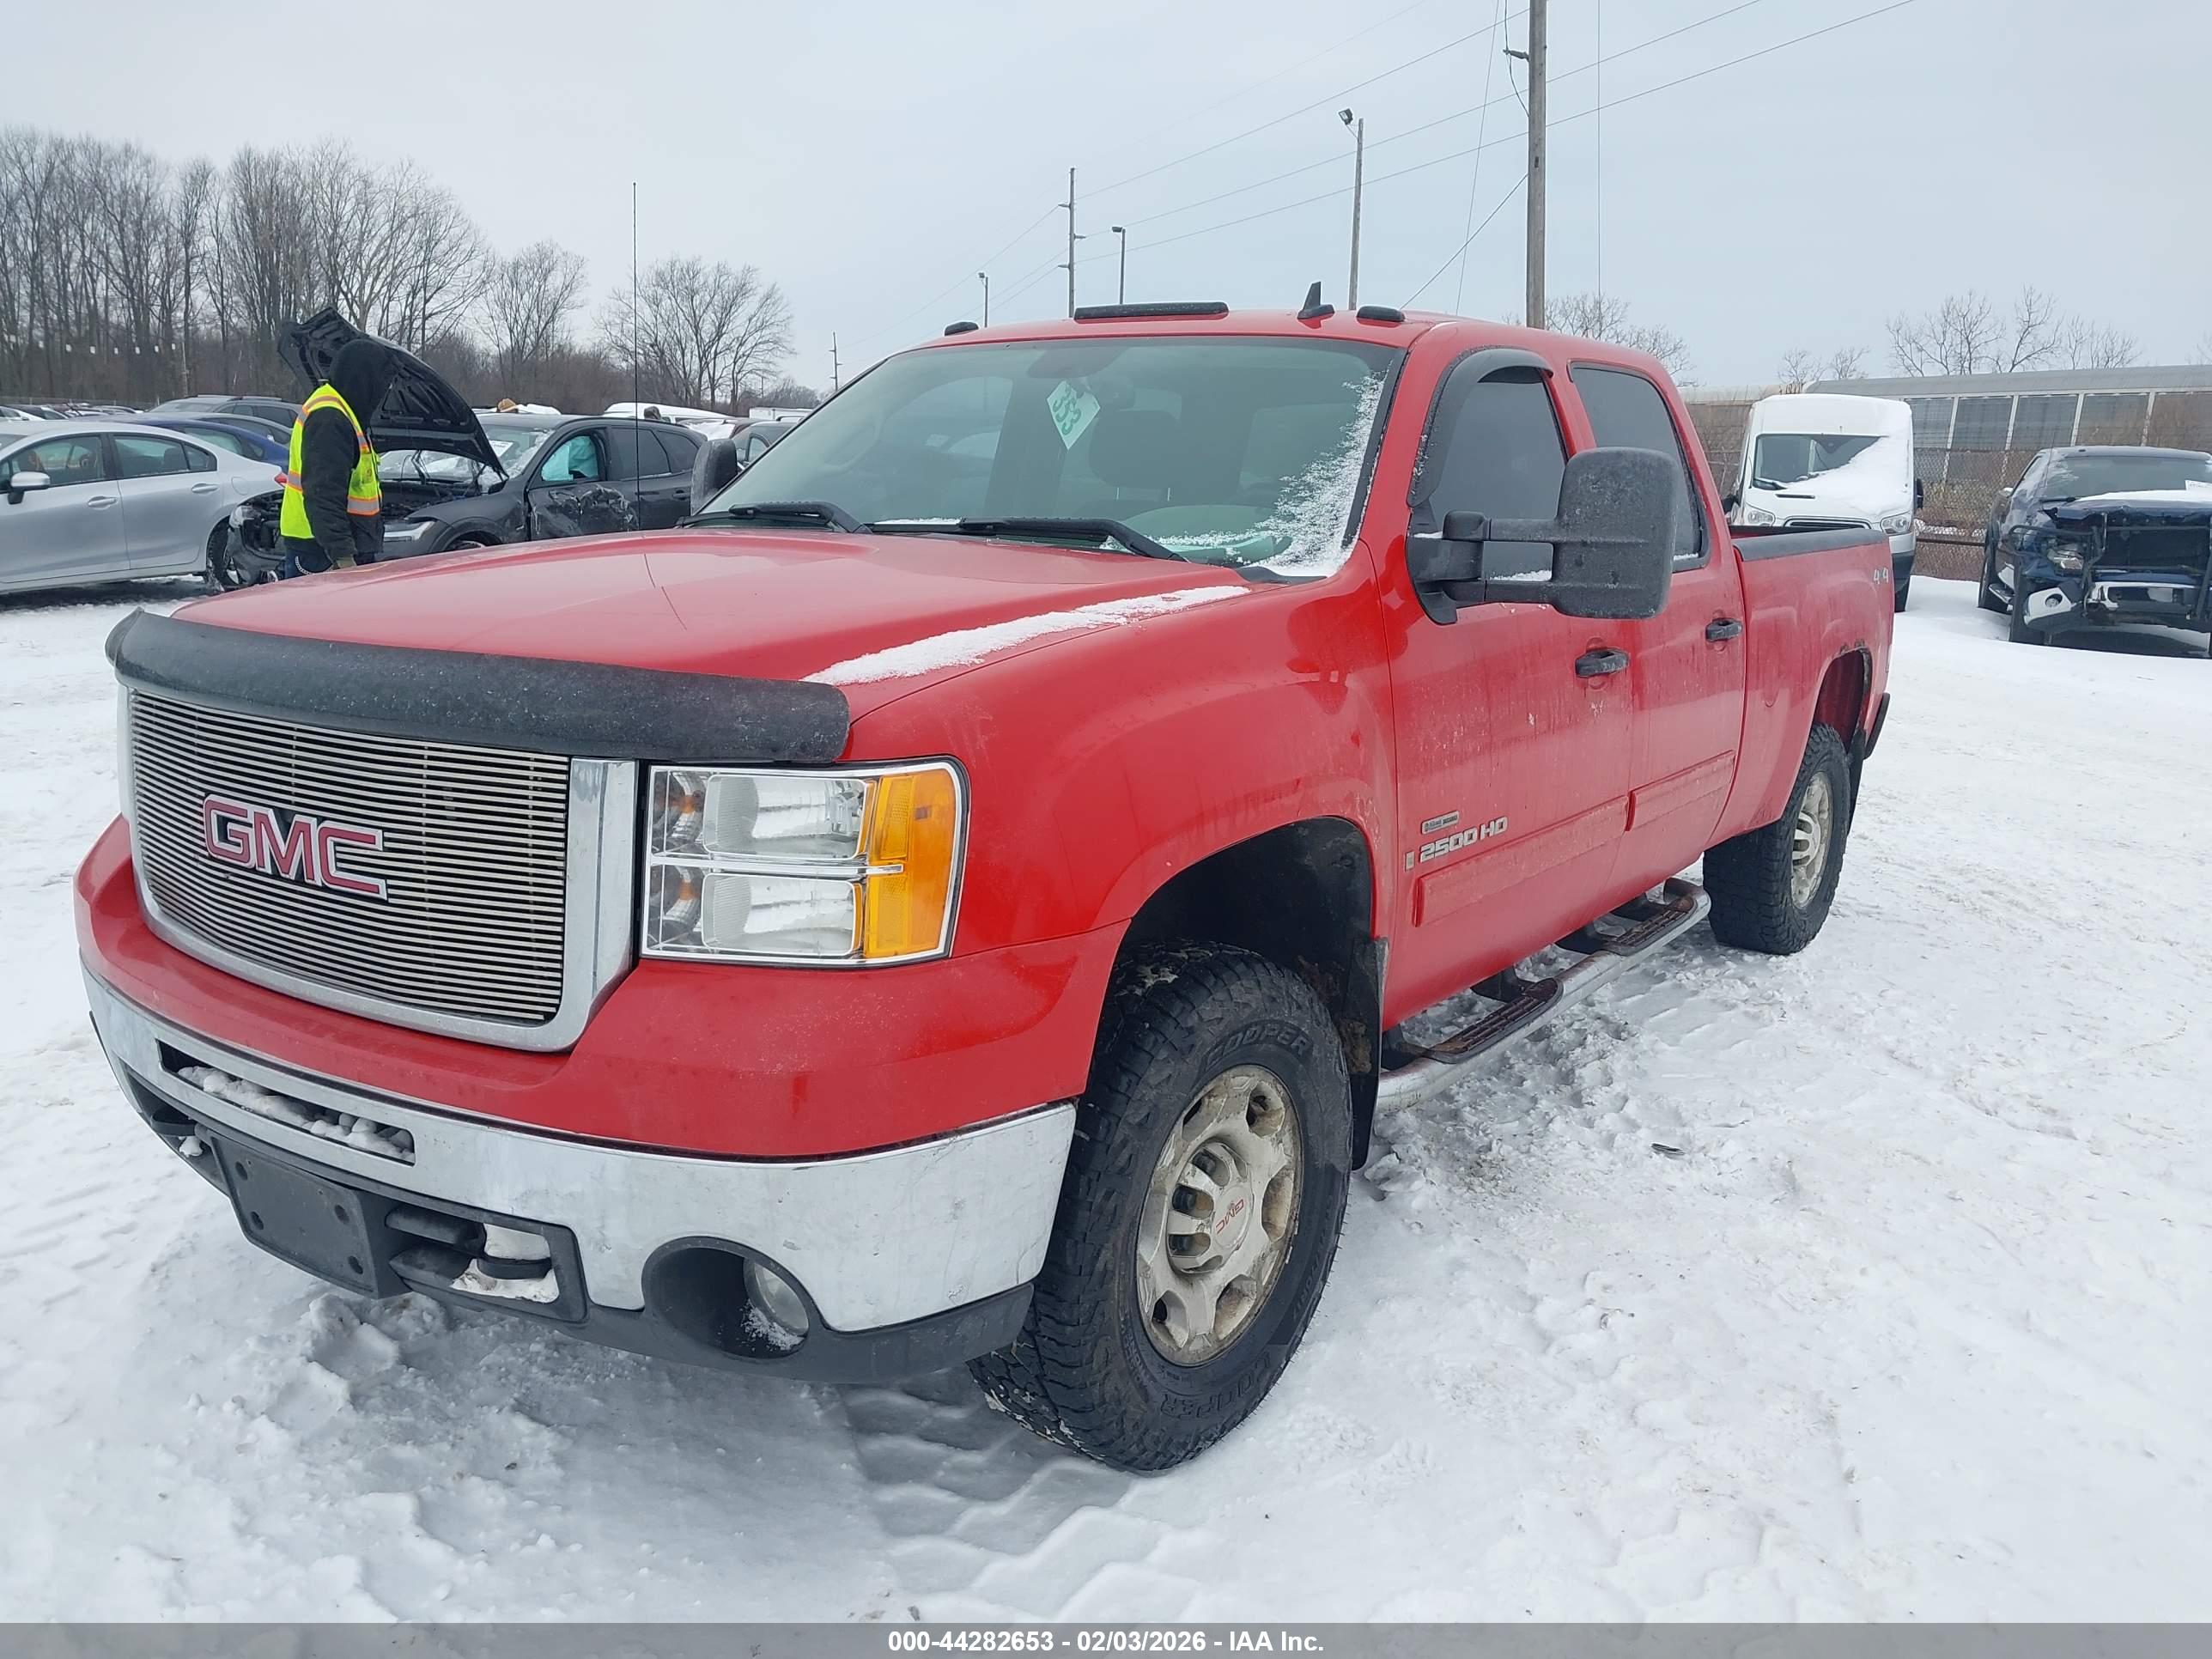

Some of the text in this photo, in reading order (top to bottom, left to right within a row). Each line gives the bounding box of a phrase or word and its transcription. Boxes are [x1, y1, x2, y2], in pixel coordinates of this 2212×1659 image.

[204, 793, 388, 900] GMC
[1419, 827, 1478, 863] 2500
[1480, 816, 1508, 841] HD
[1215, 1199, 1244, 1235] GMC
